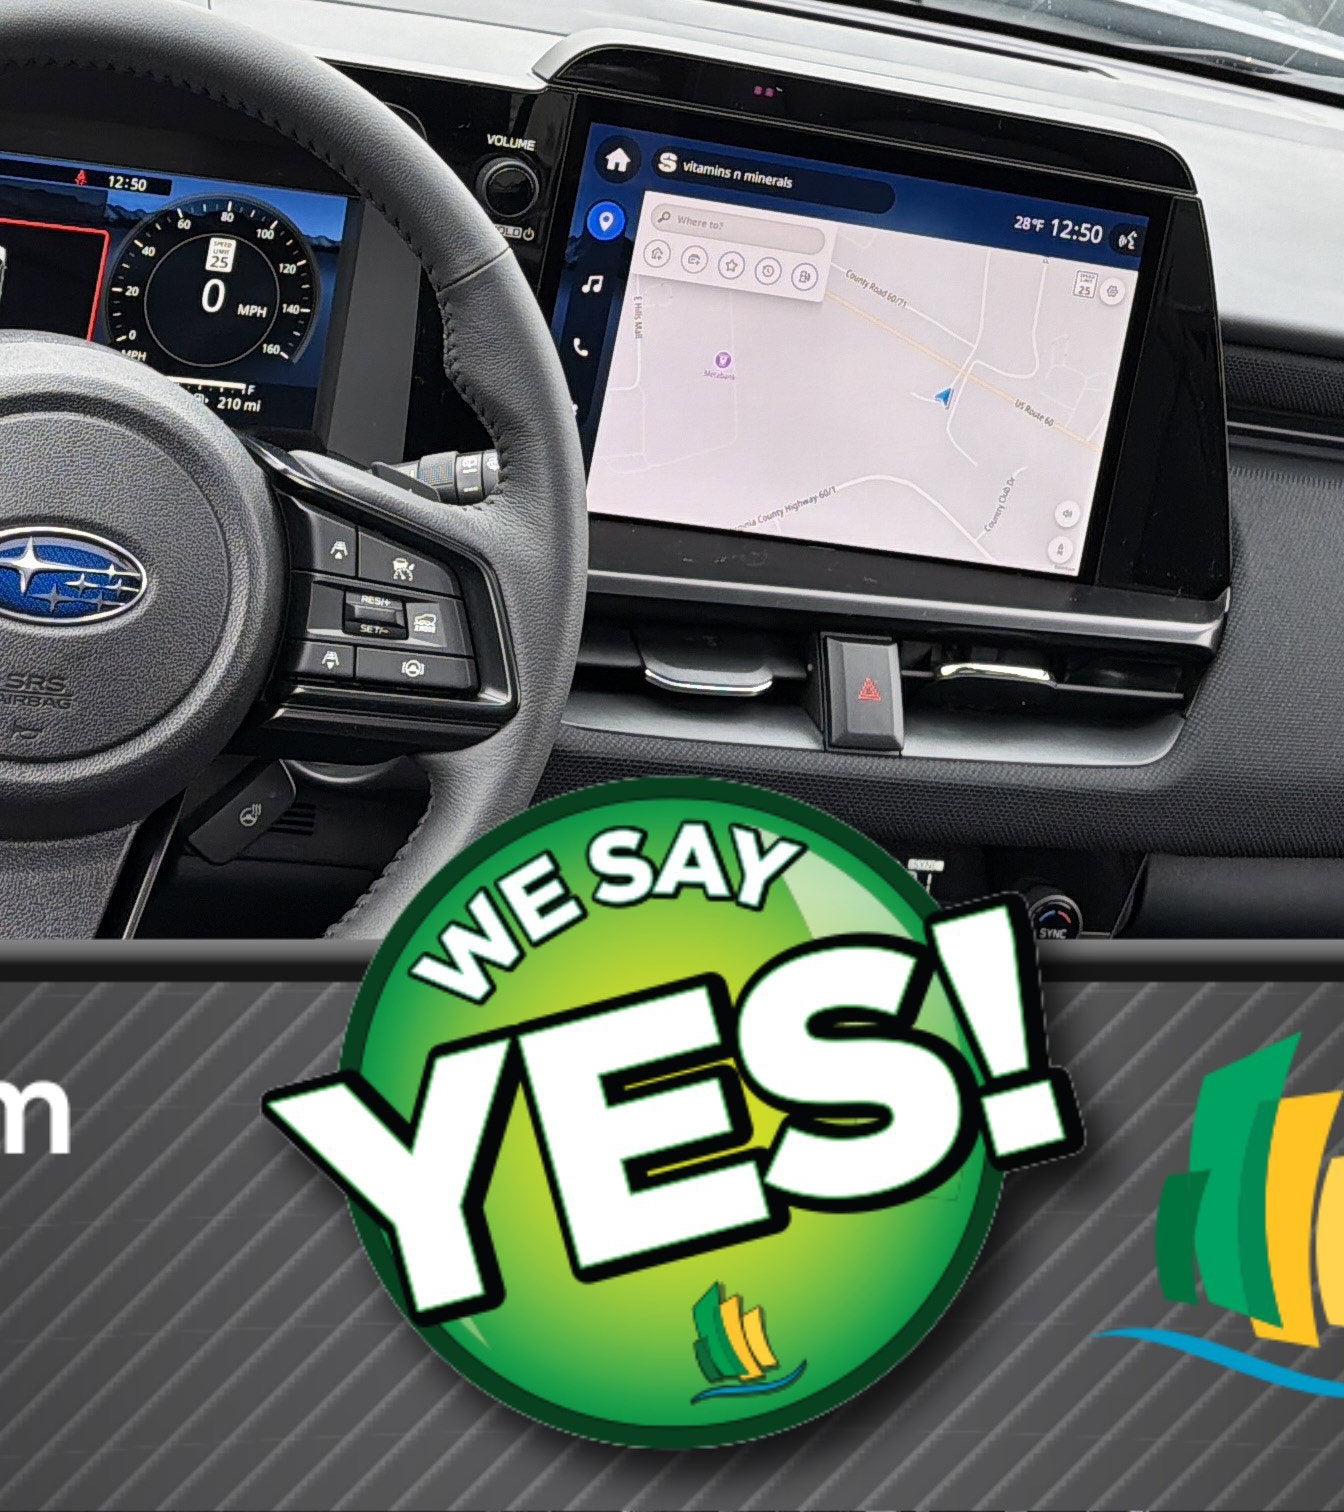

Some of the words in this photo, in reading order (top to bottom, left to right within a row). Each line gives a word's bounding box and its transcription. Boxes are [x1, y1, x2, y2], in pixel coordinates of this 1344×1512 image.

[486, 133, 536, 151] VOLUME
[682, 160, 732, 179] vitamins
[733, 170, 742, 181] n
[743, 170, 793, 189] minerals
[107, 175, 148, 192] 12:50
[220, 211, 235, 223] 80
[677, 215, 708, 228] Where
[177, 219, 192, 230] 60
[1013, 215, 1045, 233] 28°F
[1051, 218, 1103, 244] 12:50
[256, 228, 275, 240] 100
[141, 246, 156, 258] 40
[209, 255, 229, 269] 25
[278, 263, 297, 275] 120
[845, 269, 870, 289] County
[869, 282, 888, 298] Road
[1078, 285, 1091, 295] 25
[125, 285, 140, 297] 20
[201, 278, 226, 313] 0
[237, 303, 267, 319] MPH
[282, 304, 300, 316] 140
[128, 329, 137, 340] 0
[262, 343, 281, 355] 160
[247, 384, 256, 396] F
[217, 396, 241, 411] 210
[243, 400, 262, 413] mi
[1015, 398, 1026, 410] US
[1025, 405, 1045, 421] Route
[1044, 417, 1054, 427] 60
[998, 486, 1011, 504] Club
[757, 508, 784, 524] County
[784, 495, 818, 513] Highway
[6, 673, 67, 693] SRS
[1039, 927, 1067, 939] SYNC
